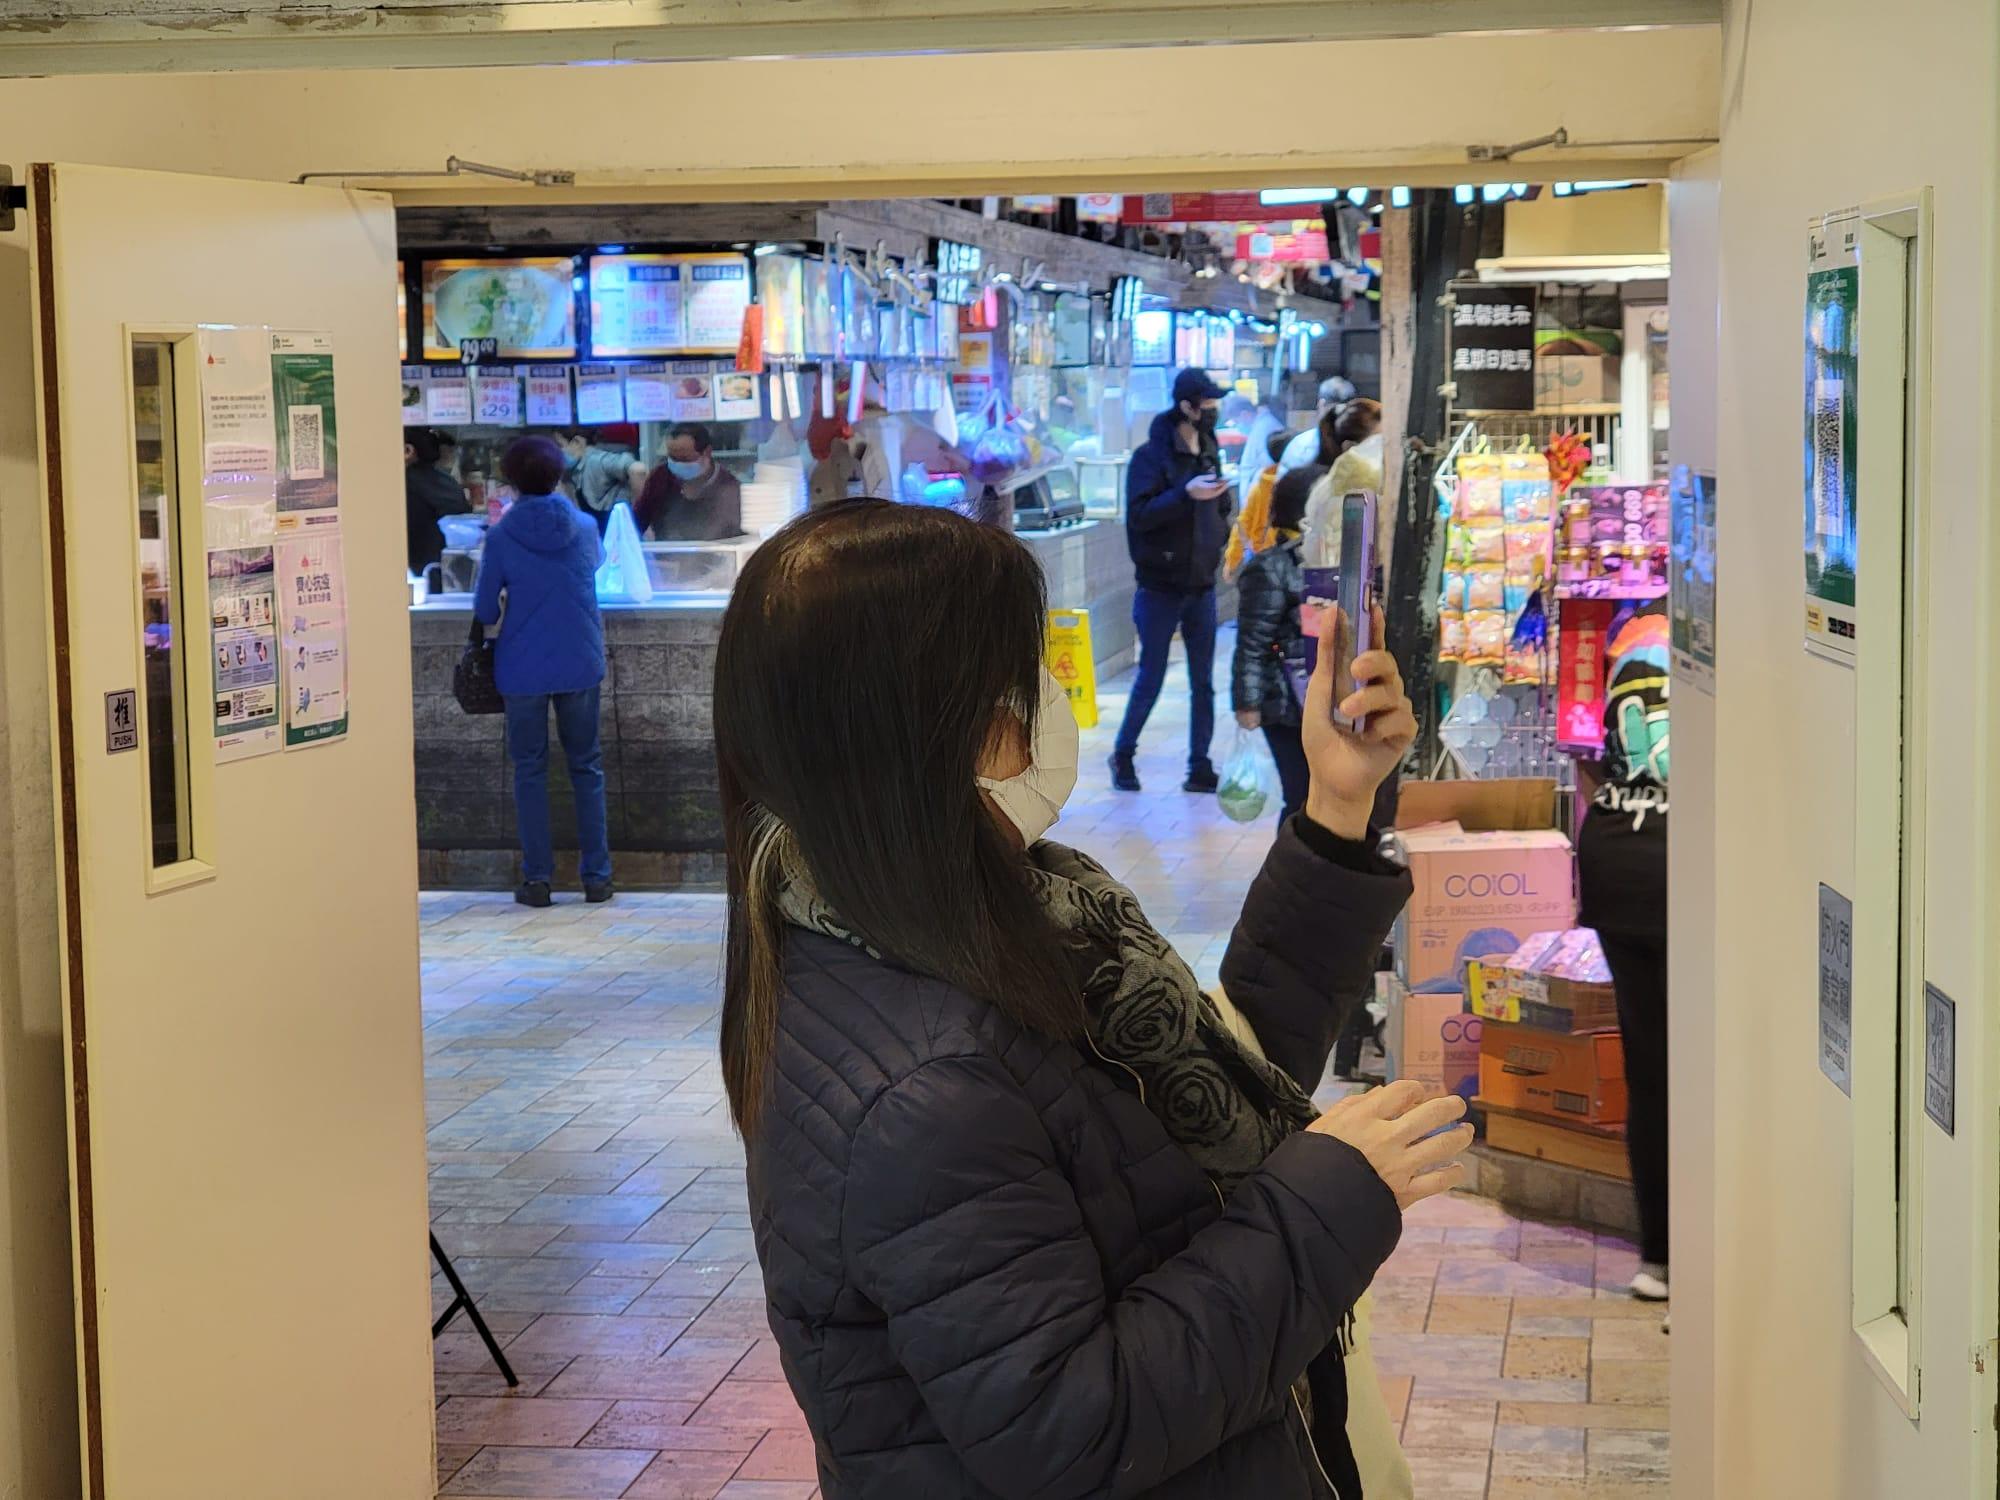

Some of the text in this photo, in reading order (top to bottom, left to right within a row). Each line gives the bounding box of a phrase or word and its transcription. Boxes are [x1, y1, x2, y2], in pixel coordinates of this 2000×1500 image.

[1453, 347, 1533, 372] 星期日跑馬
[295, 573, 331, 593] 齊心抗疫
[114, 697, 130, 729] 推
[114, 735, 133, 747] PUSH
